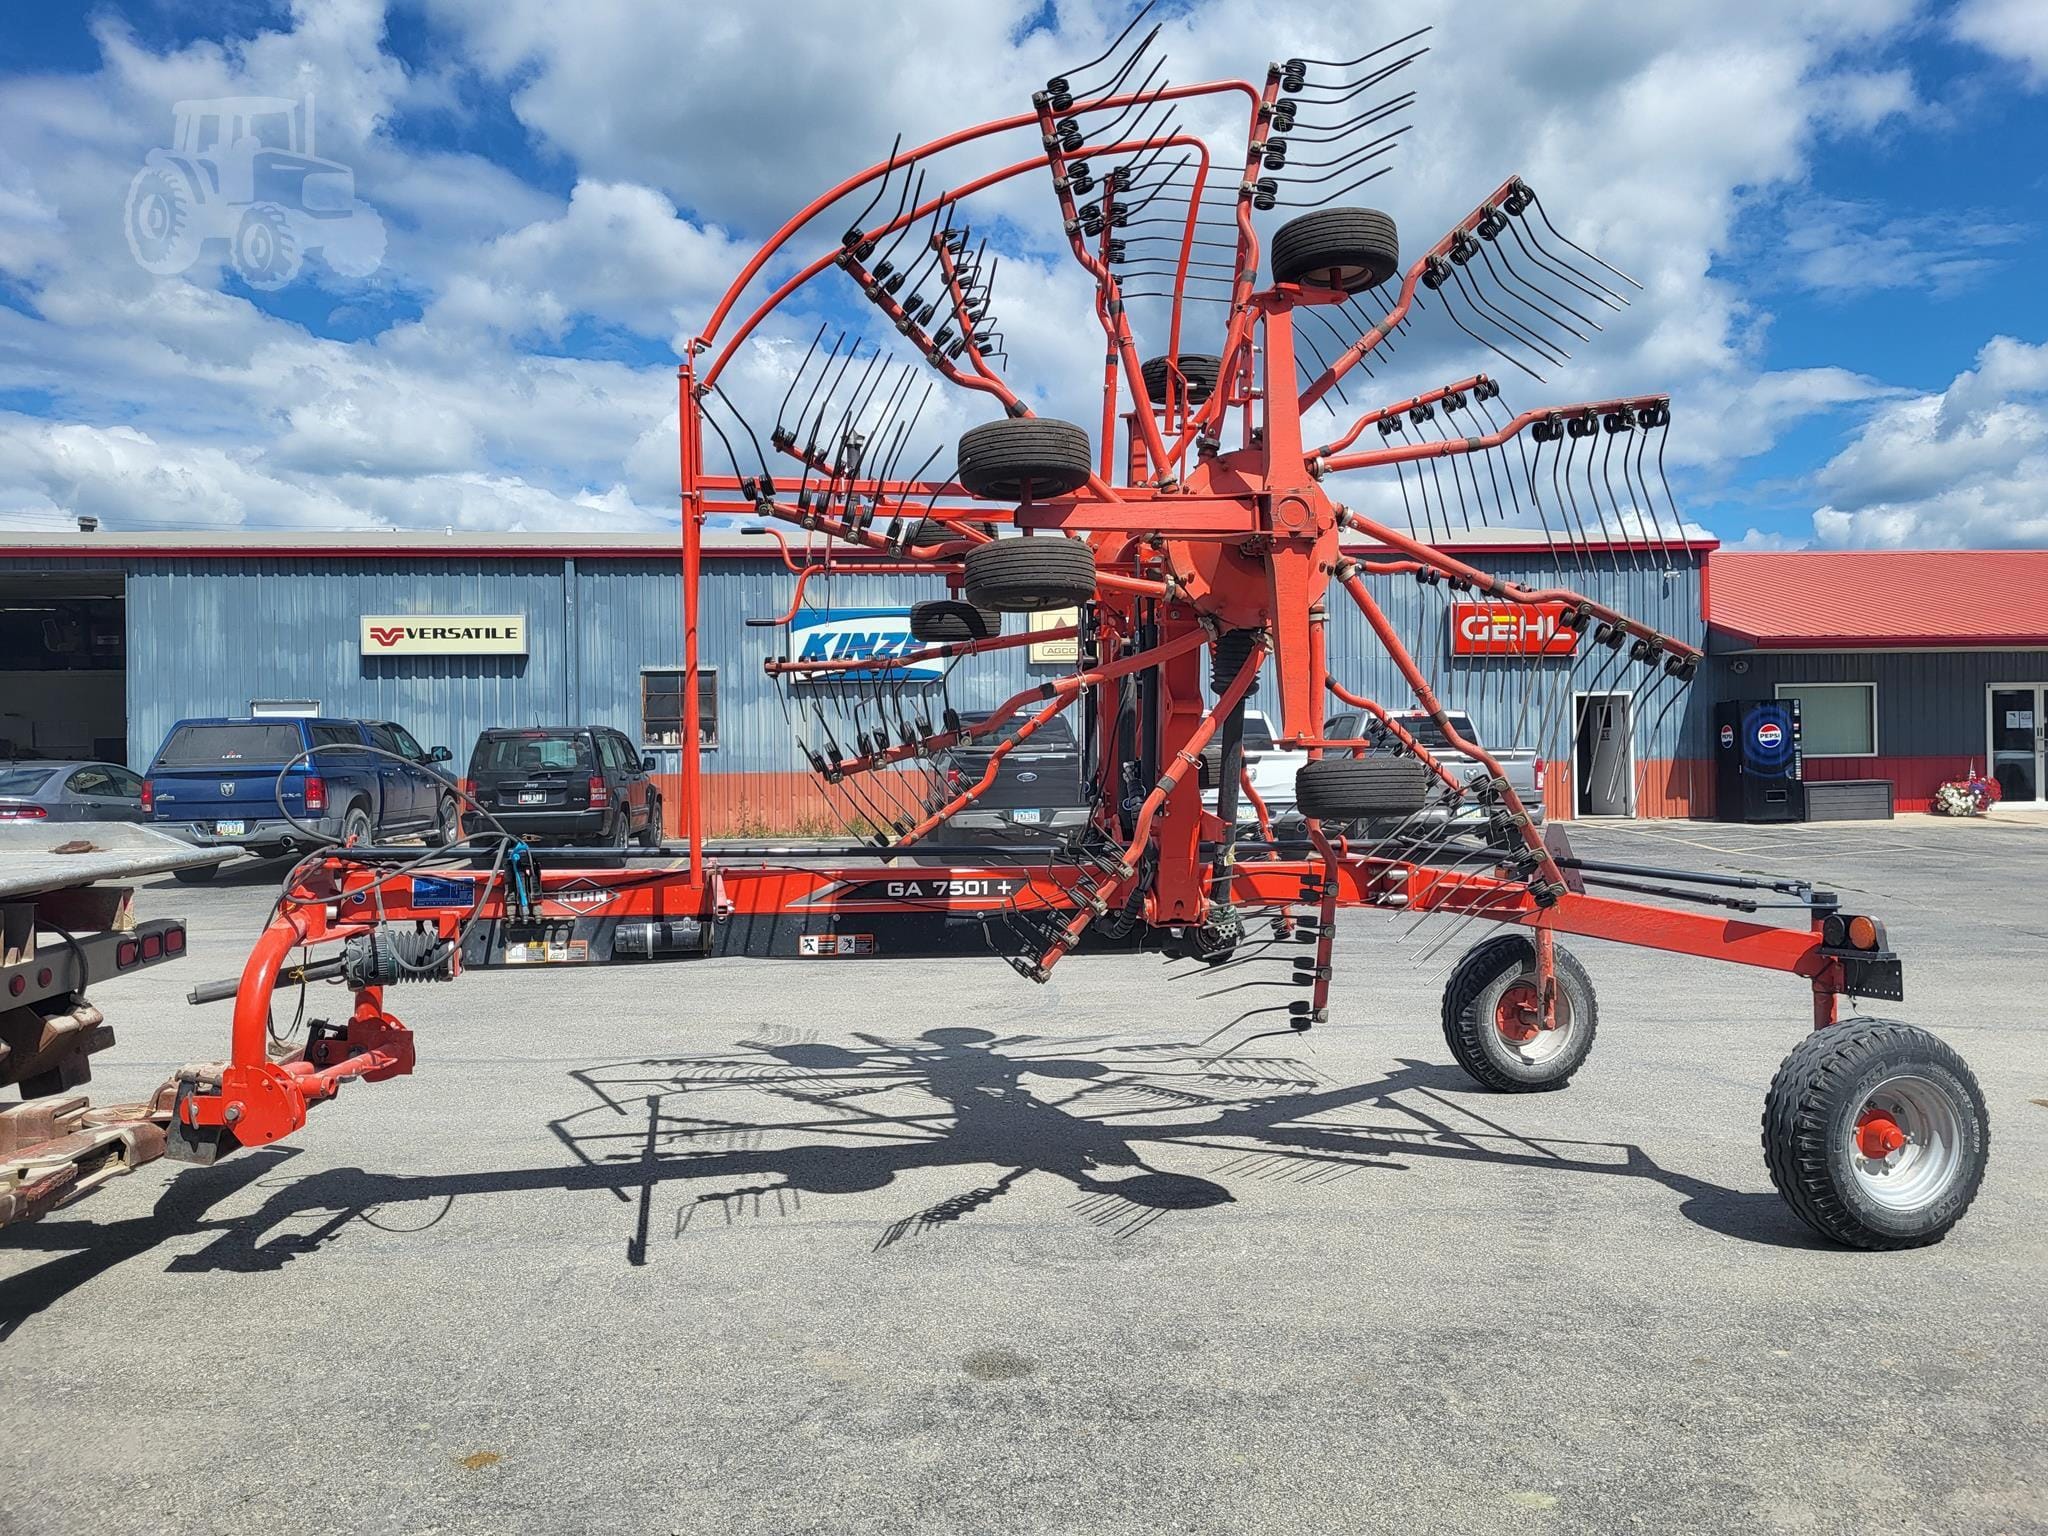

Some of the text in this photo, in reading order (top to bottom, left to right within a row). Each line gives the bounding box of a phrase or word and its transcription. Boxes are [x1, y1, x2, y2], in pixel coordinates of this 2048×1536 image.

[406, 627, 517, 639] VERSATILE
[1461, 615, 1571, 640] GEHL
[557, 889, 608, 903] KUHN
[887, 880, 1011, 897] GA 7501 +
